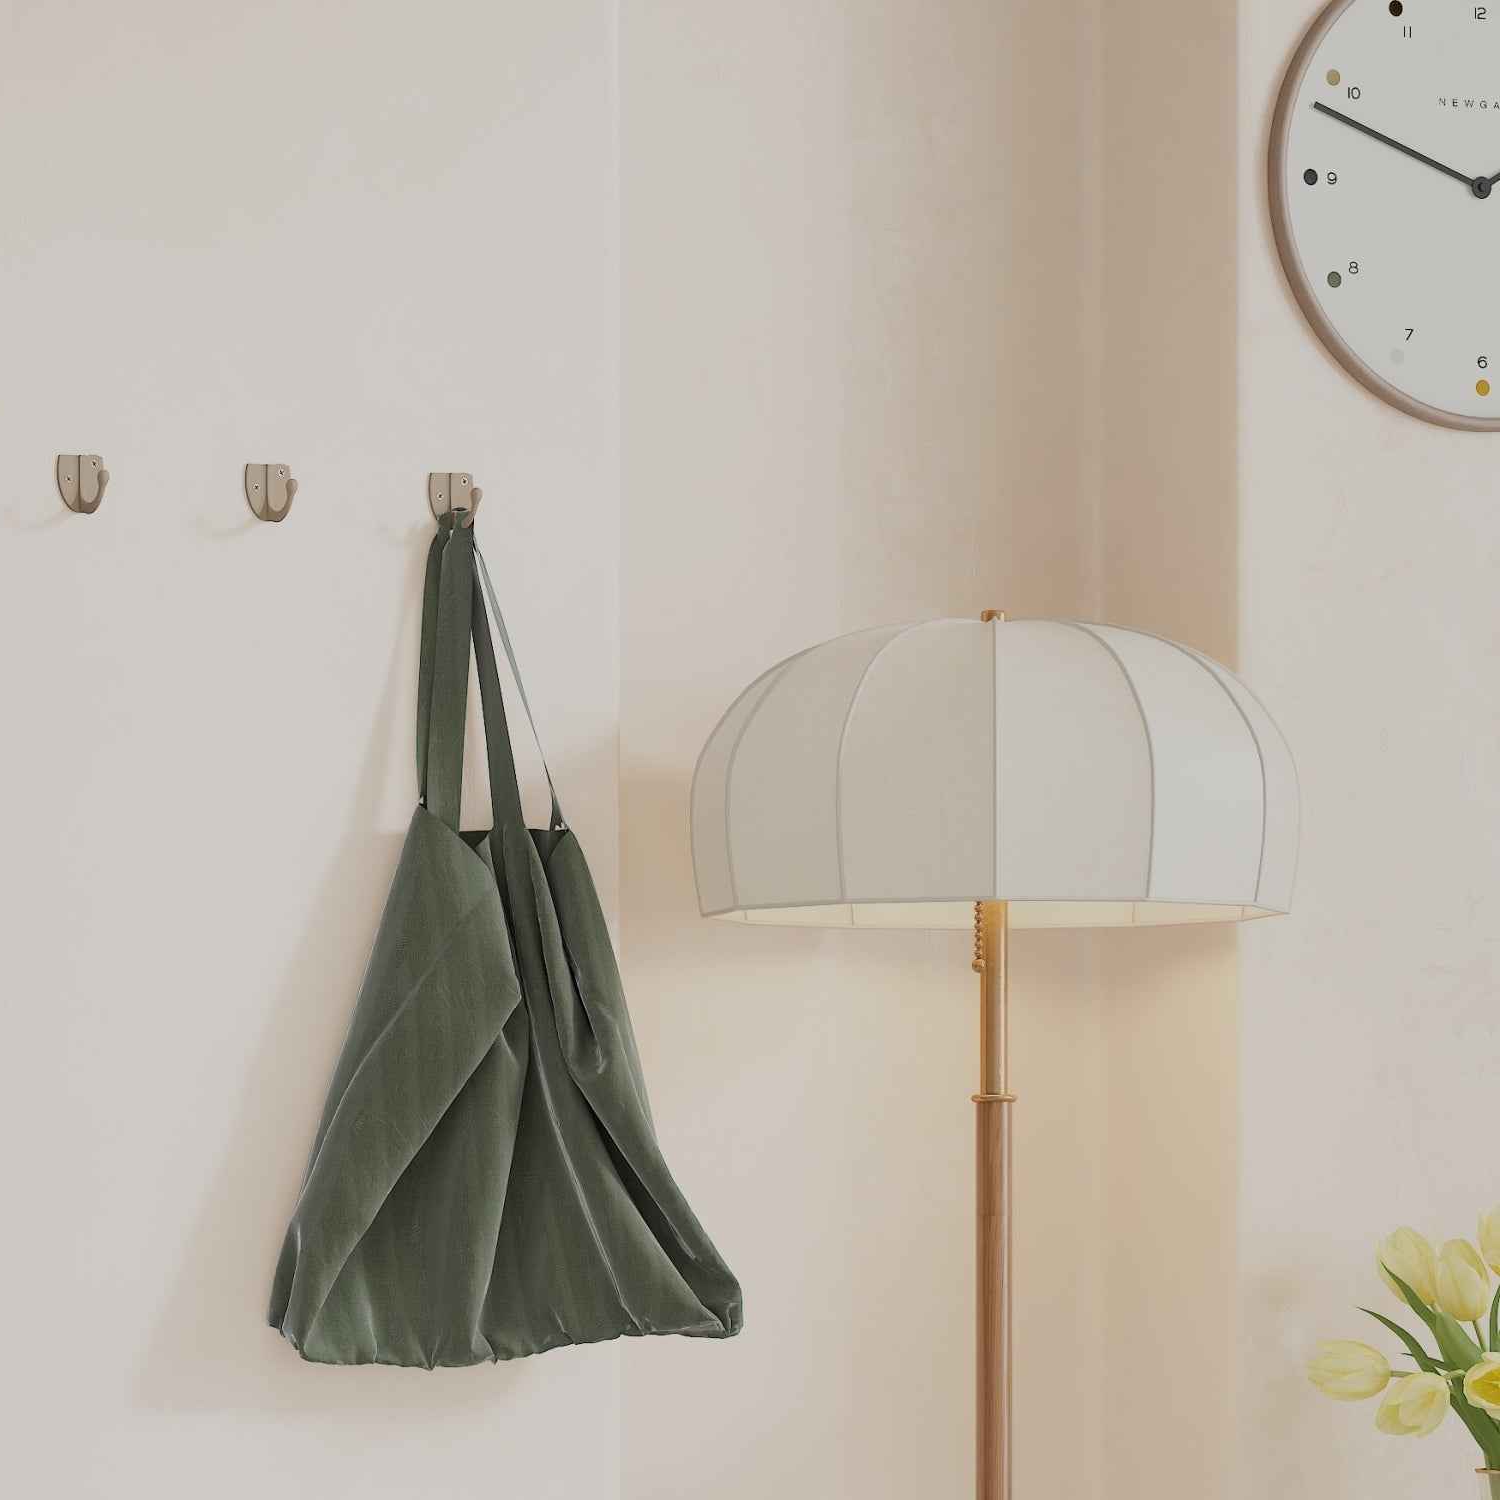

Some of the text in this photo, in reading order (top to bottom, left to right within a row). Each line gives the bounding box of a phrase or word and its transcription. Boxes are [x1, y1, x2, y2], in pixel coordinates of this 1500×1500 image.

[1474, 7, 1487, 20] 12
[1403, 25, 1412, 39] 11
[1347, 87, 1361, 100] 10
[1327, 172, 1337, 185] 9
[1348, 262, 1359, 274] 8
[1404, 328, 1414, 341] 7
[1477, 356, 1488, 369] 6
